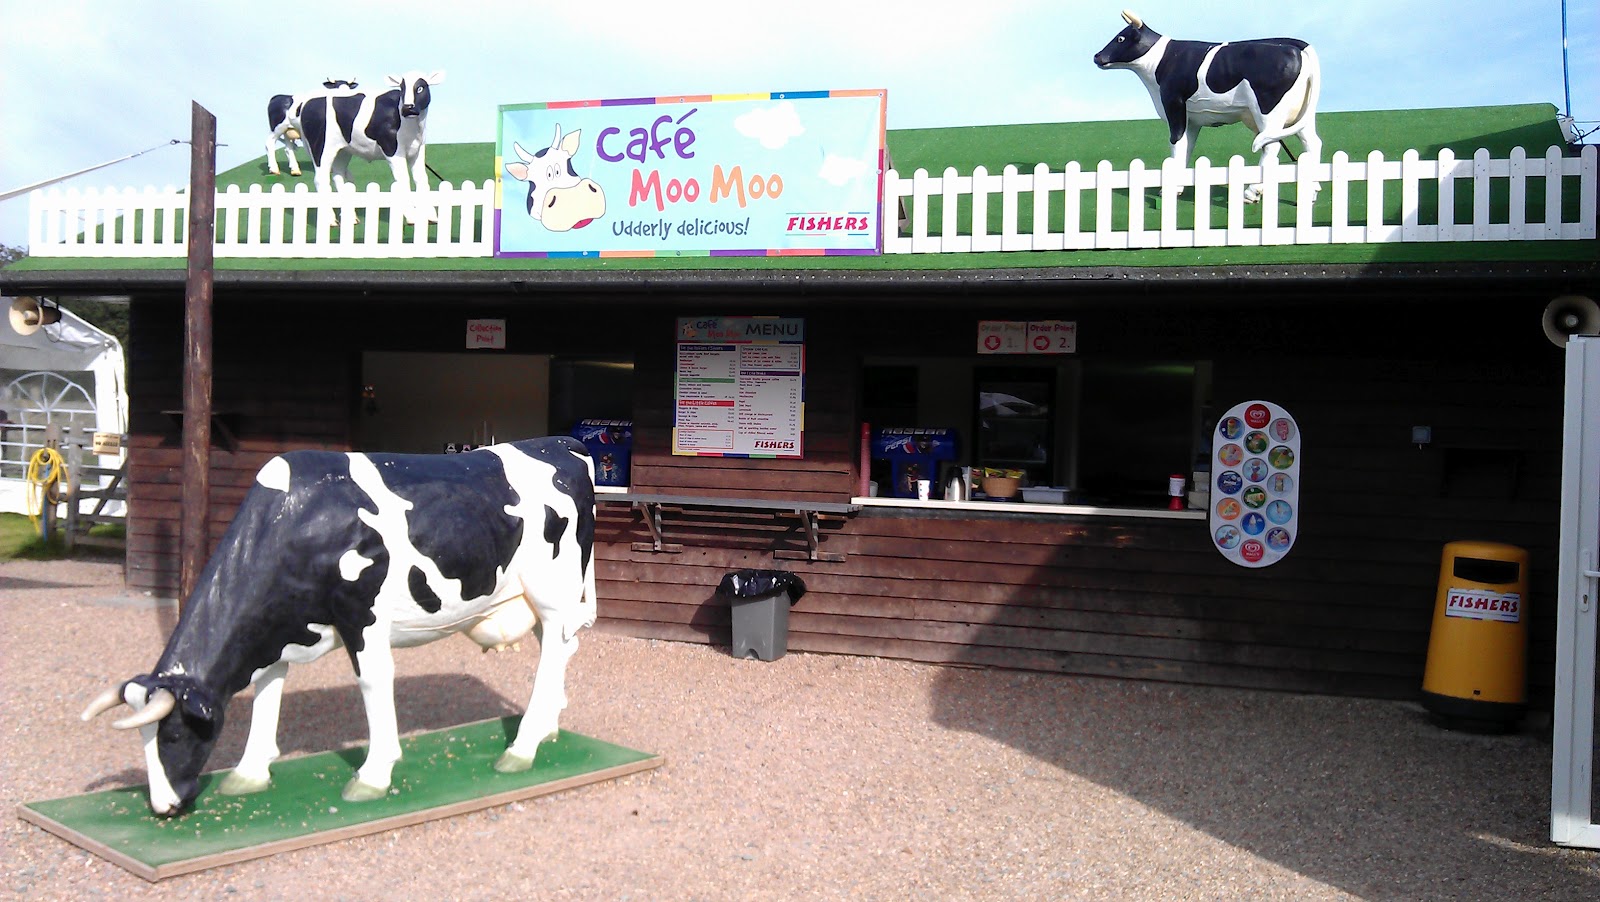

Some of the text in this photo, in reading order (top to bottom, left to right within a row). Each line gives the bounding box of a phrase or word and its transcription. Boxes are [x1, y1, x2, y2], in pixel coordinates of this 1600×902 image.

[628, 164, 784, 212] Moo Moo
[612, 217, 750, 240] Udderly delicious!
[786, 213, 869, 231] FISHERS
[745, 323, 798, 336] MENU
[1030, 323, 1075, 334] Order Point
[755, 440, 795, 449] FISHERS
[1448, 595, 1518, 613] FISHERS
